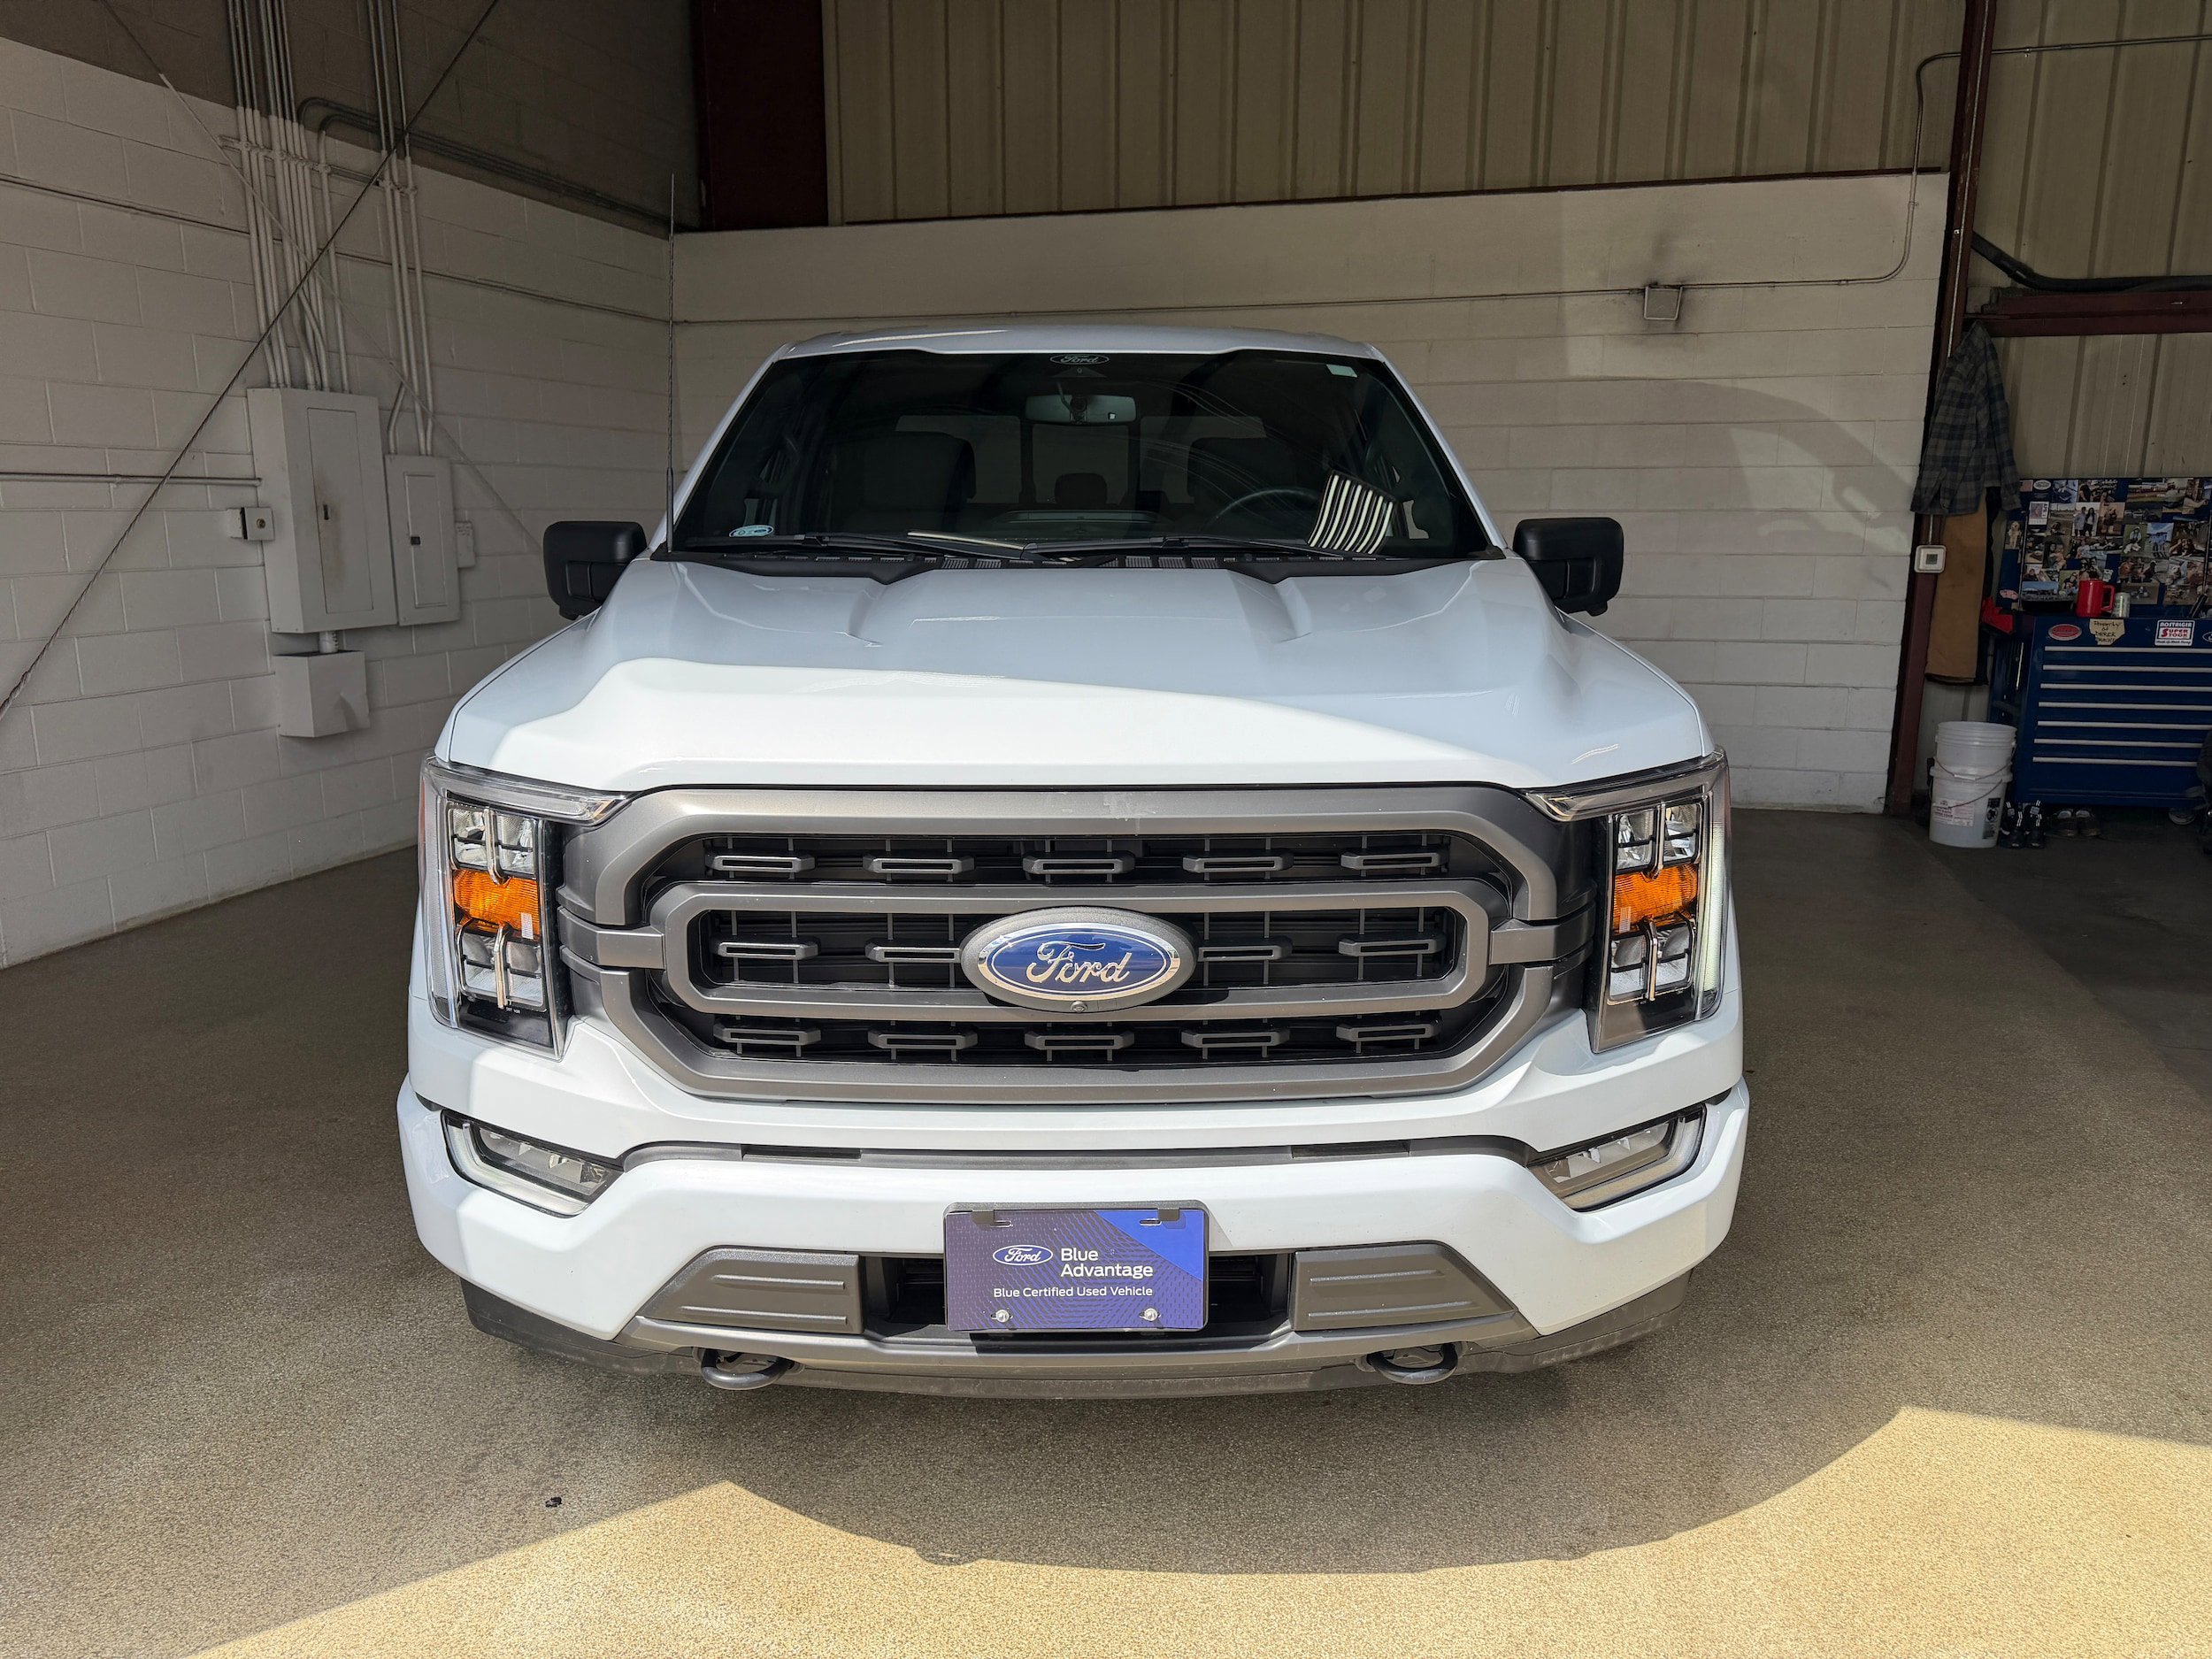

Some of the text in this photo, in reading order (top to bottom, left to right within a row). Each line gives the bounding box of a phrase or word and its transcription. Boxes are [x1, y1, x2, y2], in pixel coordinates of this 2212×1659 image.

[1026, 941, 1133, 983] Ford
[1003, 1247, 1042, 1263] Ford
[1061, 1248, 1099, 1262] Blue
[1060, 1263, 1154, 1279] Advantage
[994, 1286, 1153, 1297] Blue Certified Used Vehicle
